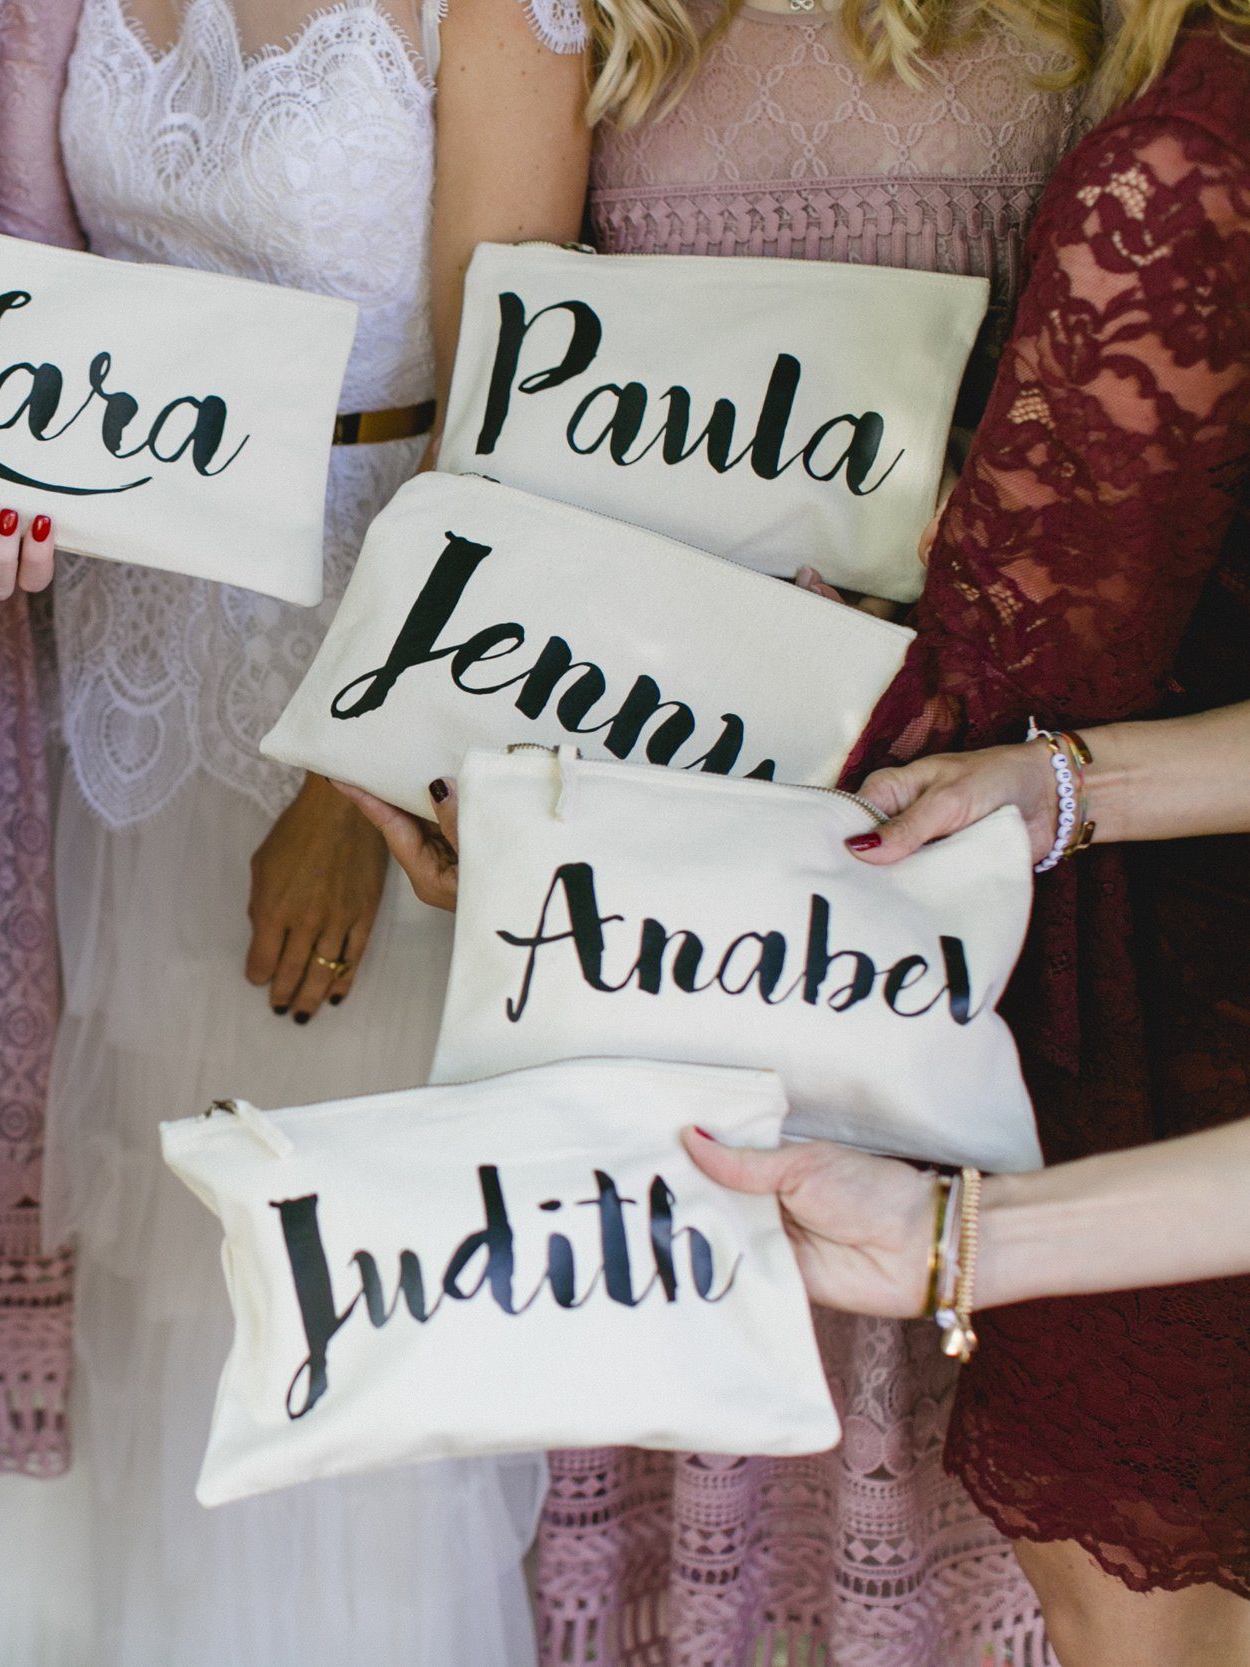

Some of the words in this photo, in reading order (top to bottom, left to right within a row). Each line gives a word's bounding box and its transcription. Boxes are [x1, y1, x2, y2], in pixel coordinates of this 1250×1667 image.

[474, 290, 906, 498] Paula
[495, 860, 974, 1027] Anabel
[268, 1163, 744, 1421] Judith
